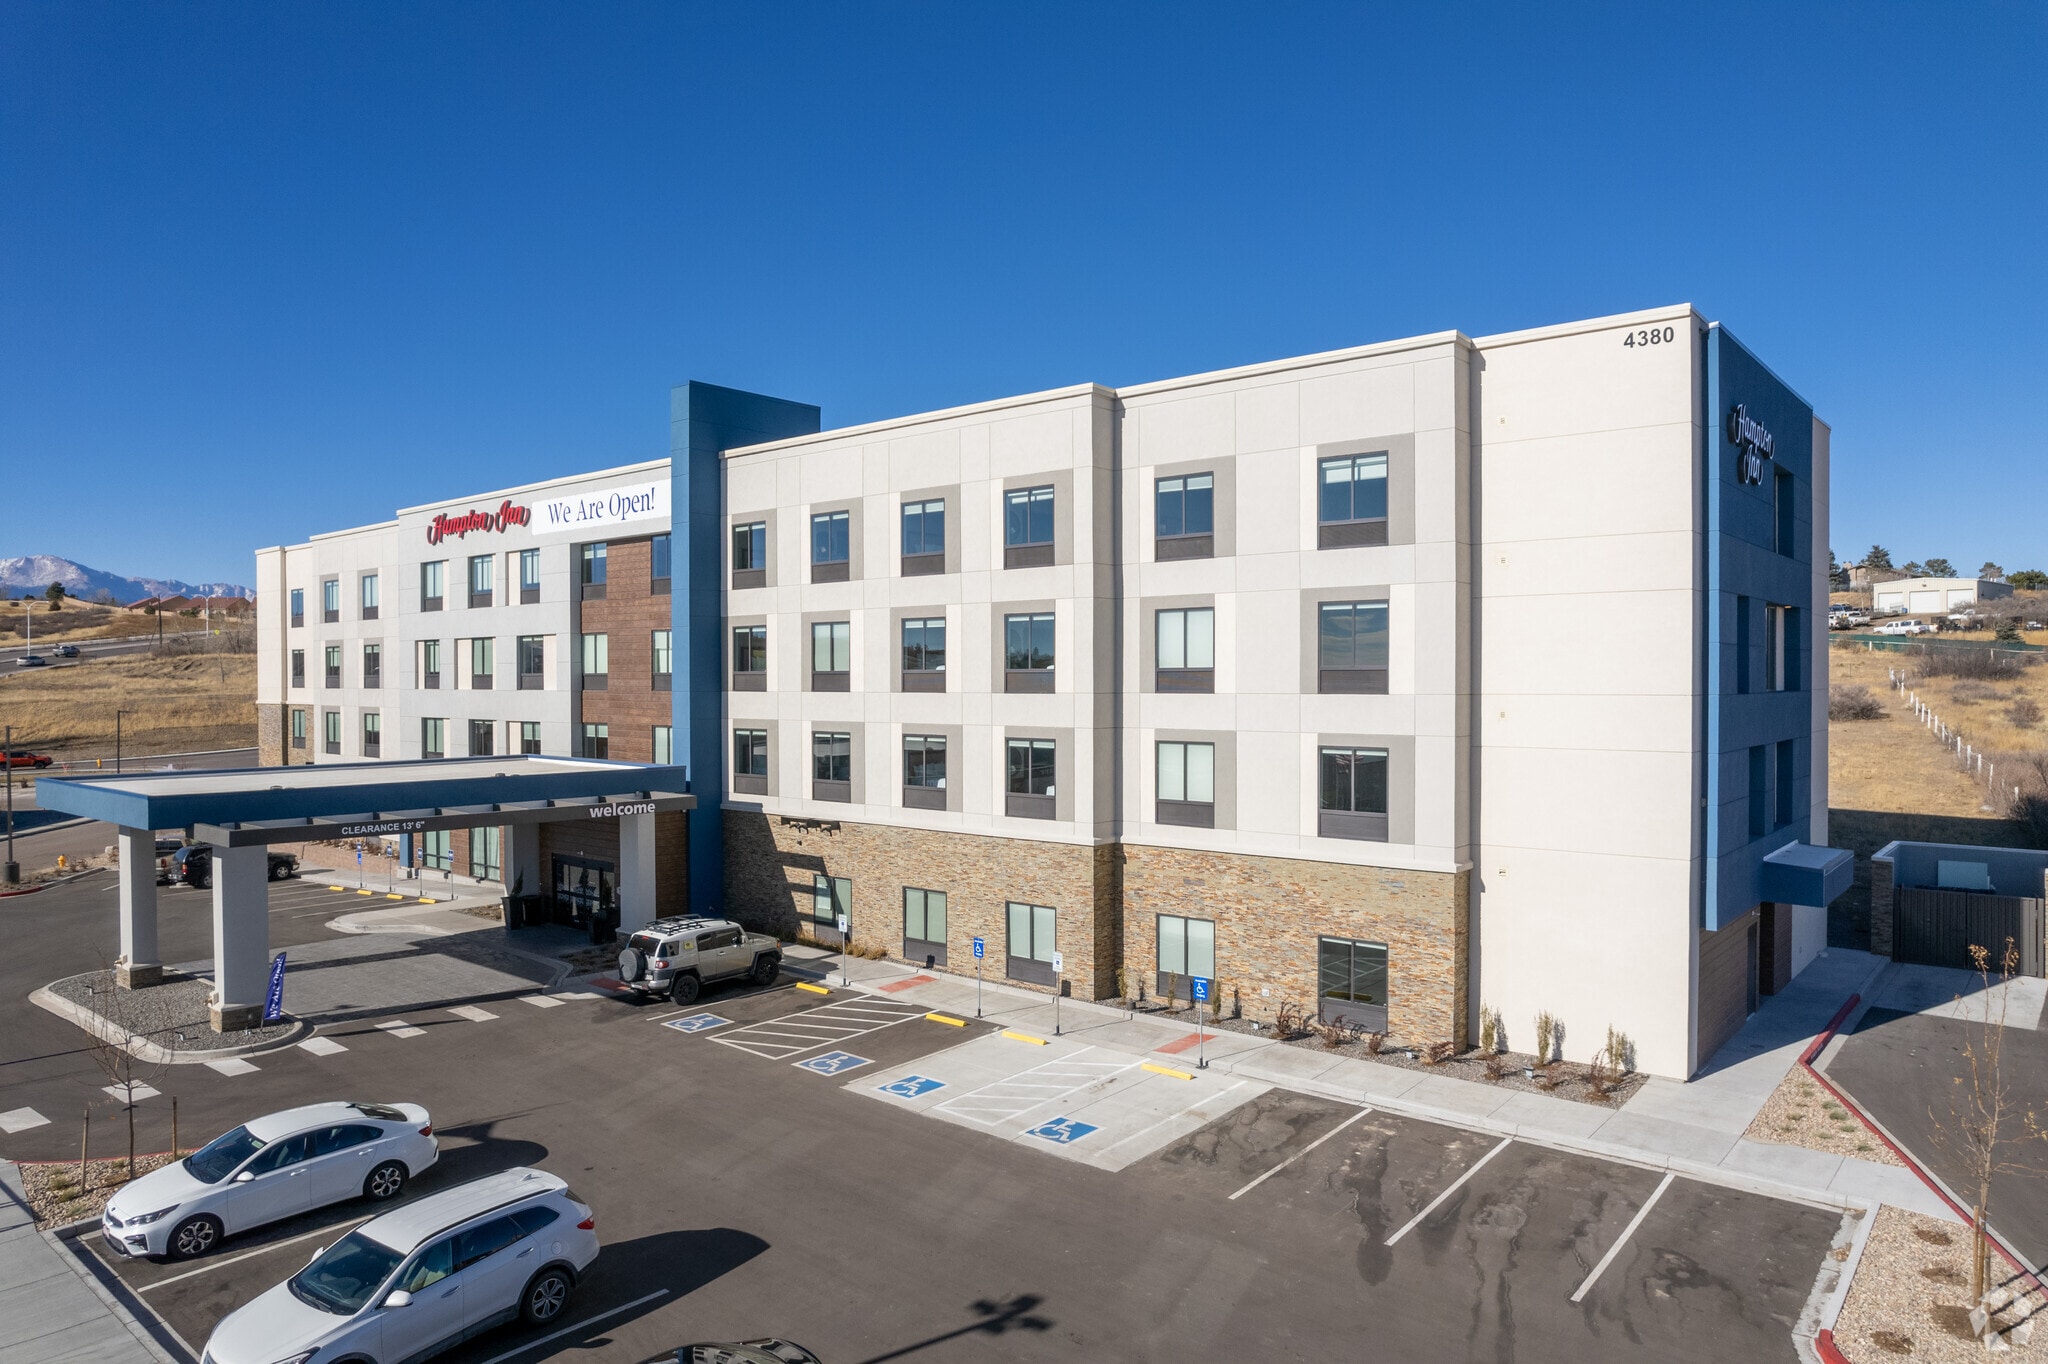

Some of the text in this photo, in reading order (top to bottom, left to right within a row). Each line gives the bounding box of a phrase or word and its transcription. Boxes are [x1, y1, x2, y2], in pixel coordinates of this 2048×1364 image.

[1623, 327, 1675, 348] 4380
[1733, 404, 1775, 459] Hampton
[1743, 445, 1763, 485] Inn
[428, 500, 530, 545] Hampton Inn
[548, 487, 655, 525] We Are Open!
[341, 823, 400, 835] CLEARANCE
[589, 802, 656, 818] welcome
